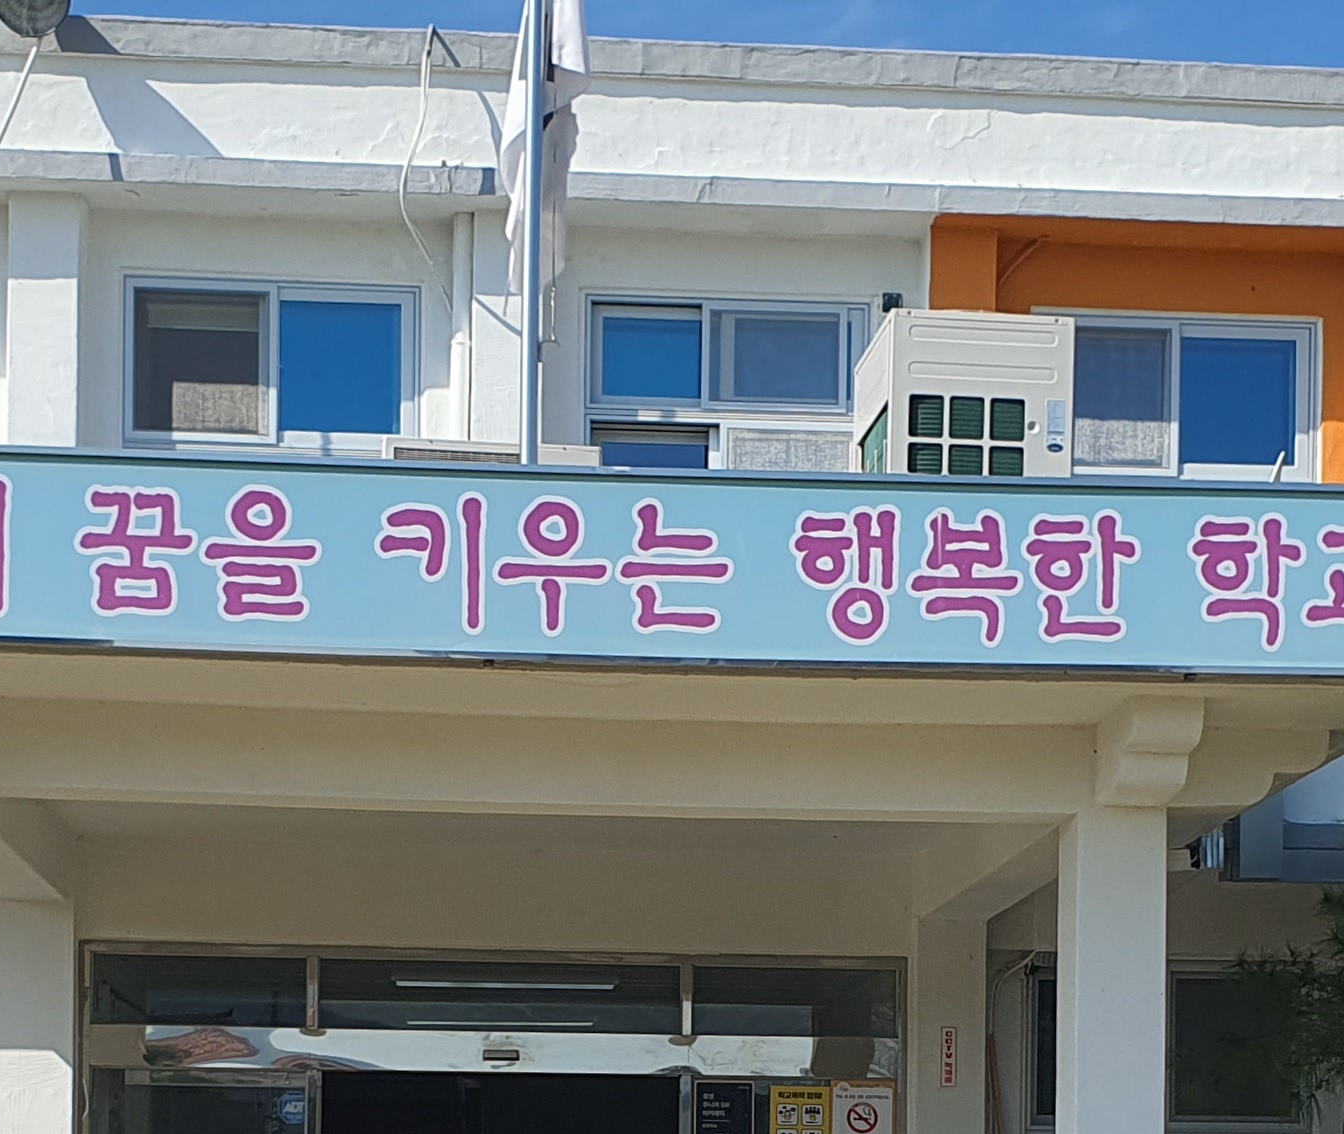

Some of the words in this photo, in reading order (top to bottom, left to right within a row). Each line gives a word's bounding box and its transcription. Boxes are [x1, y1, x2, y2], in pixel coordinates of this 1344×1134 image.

[76, 484, 321, 621] 꿈을
[376, 489, 733, 638] 키우는
[791, 502, 1139, 649] 행복한
[944, 1030, 953, 1059] CCTV
[283, 1101, 306, 1114] ADT
